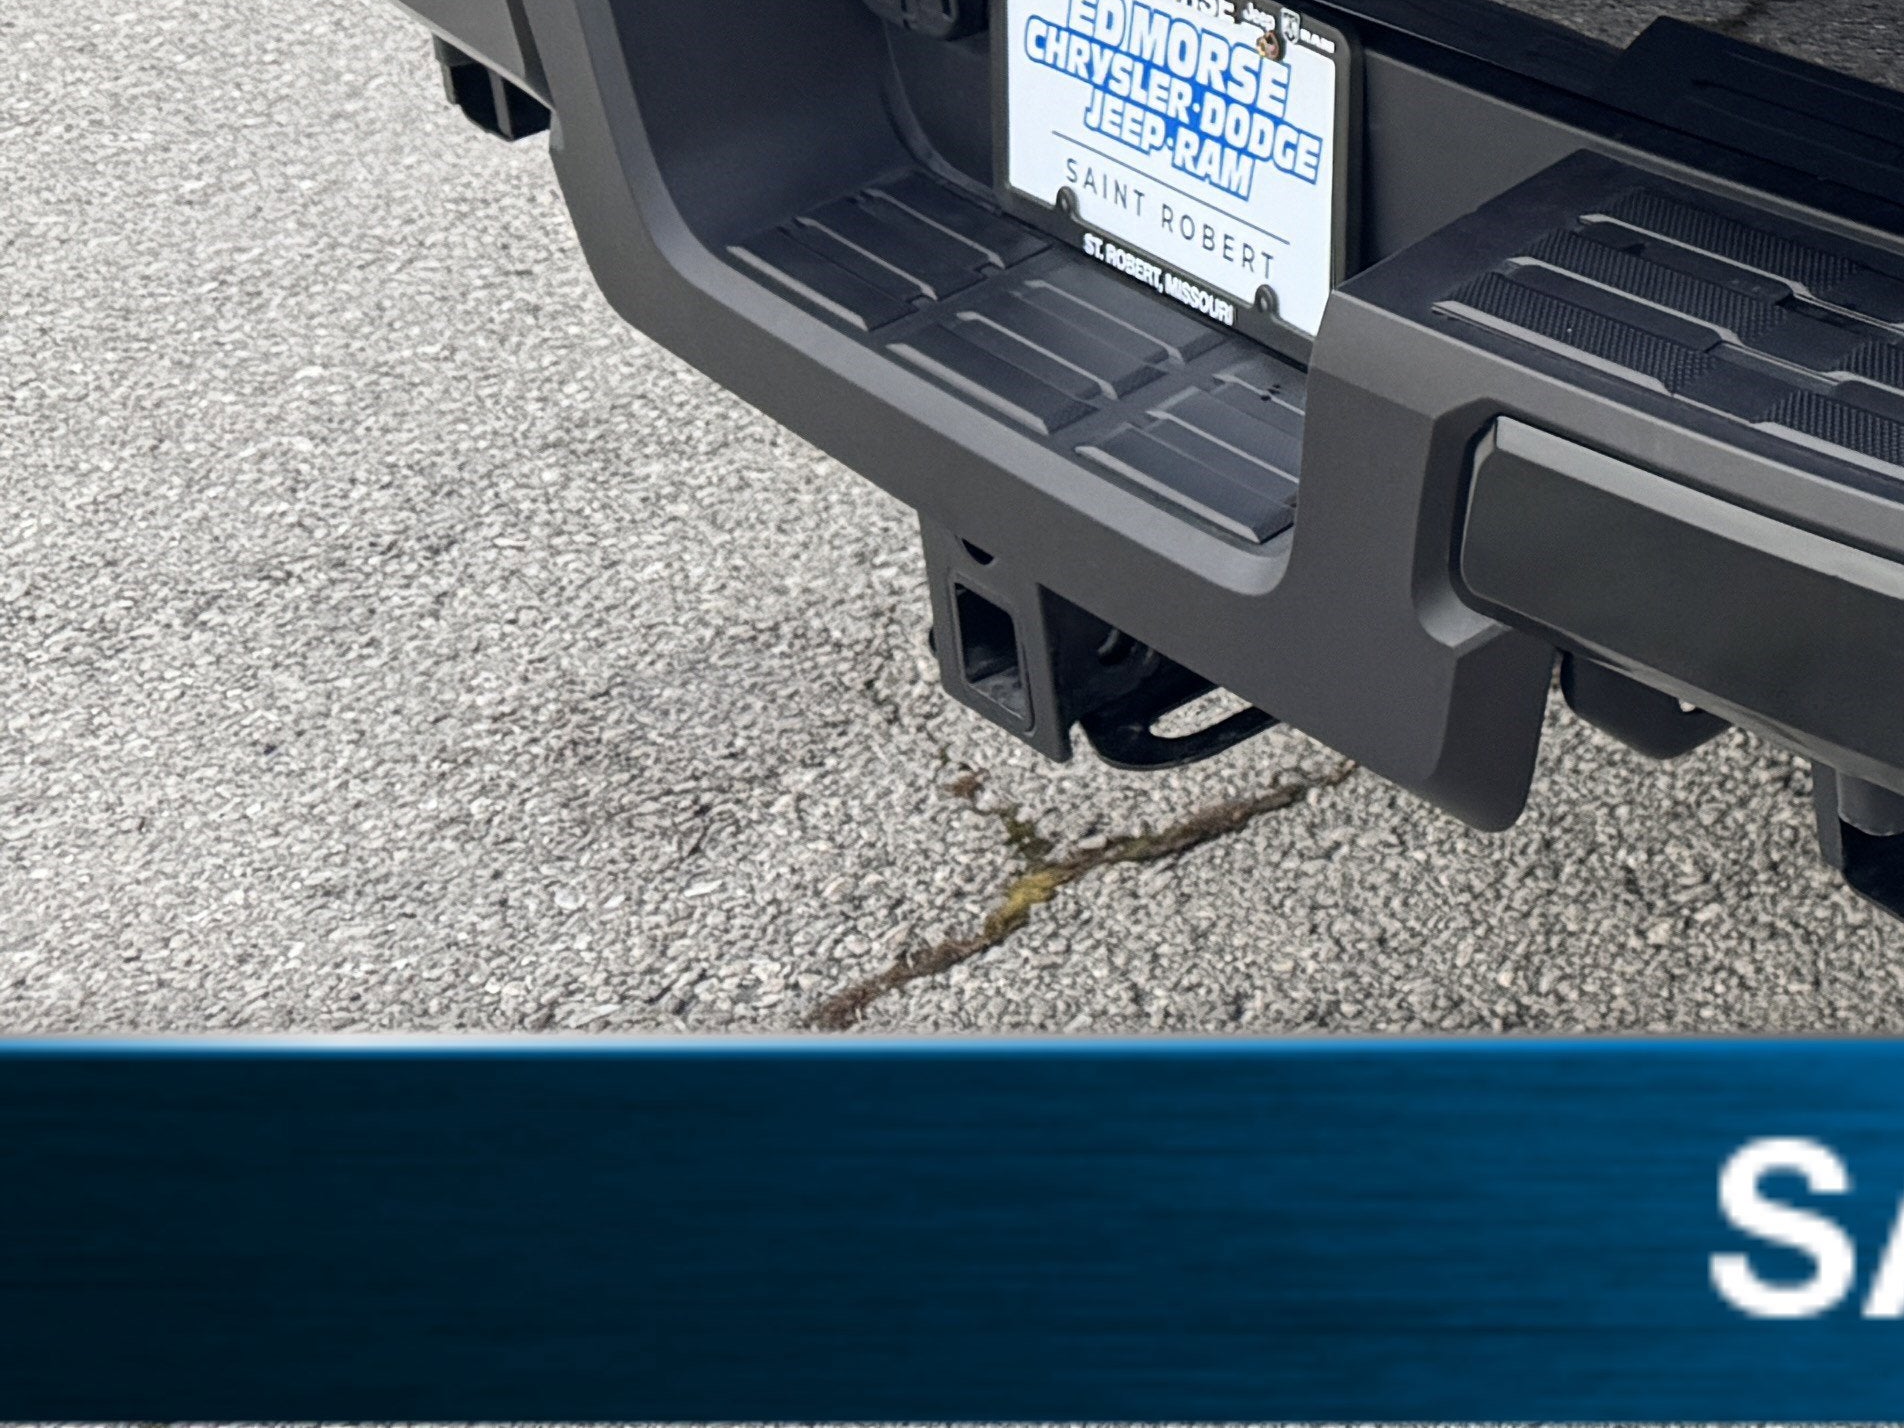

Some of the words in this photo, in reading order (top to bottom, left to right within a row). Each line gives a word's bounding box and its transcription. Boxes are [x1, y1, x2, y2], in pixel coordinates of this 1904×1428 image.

[1129, 2, 1290, 120] MORSE
[1066, 158, 1146, 217] SAINT
[1162, 204, 1276, 280] ROBERT
[1106, 244, 1164, 294] ROBERT,
[1165, 274, 1235, 326] MISSOURI
